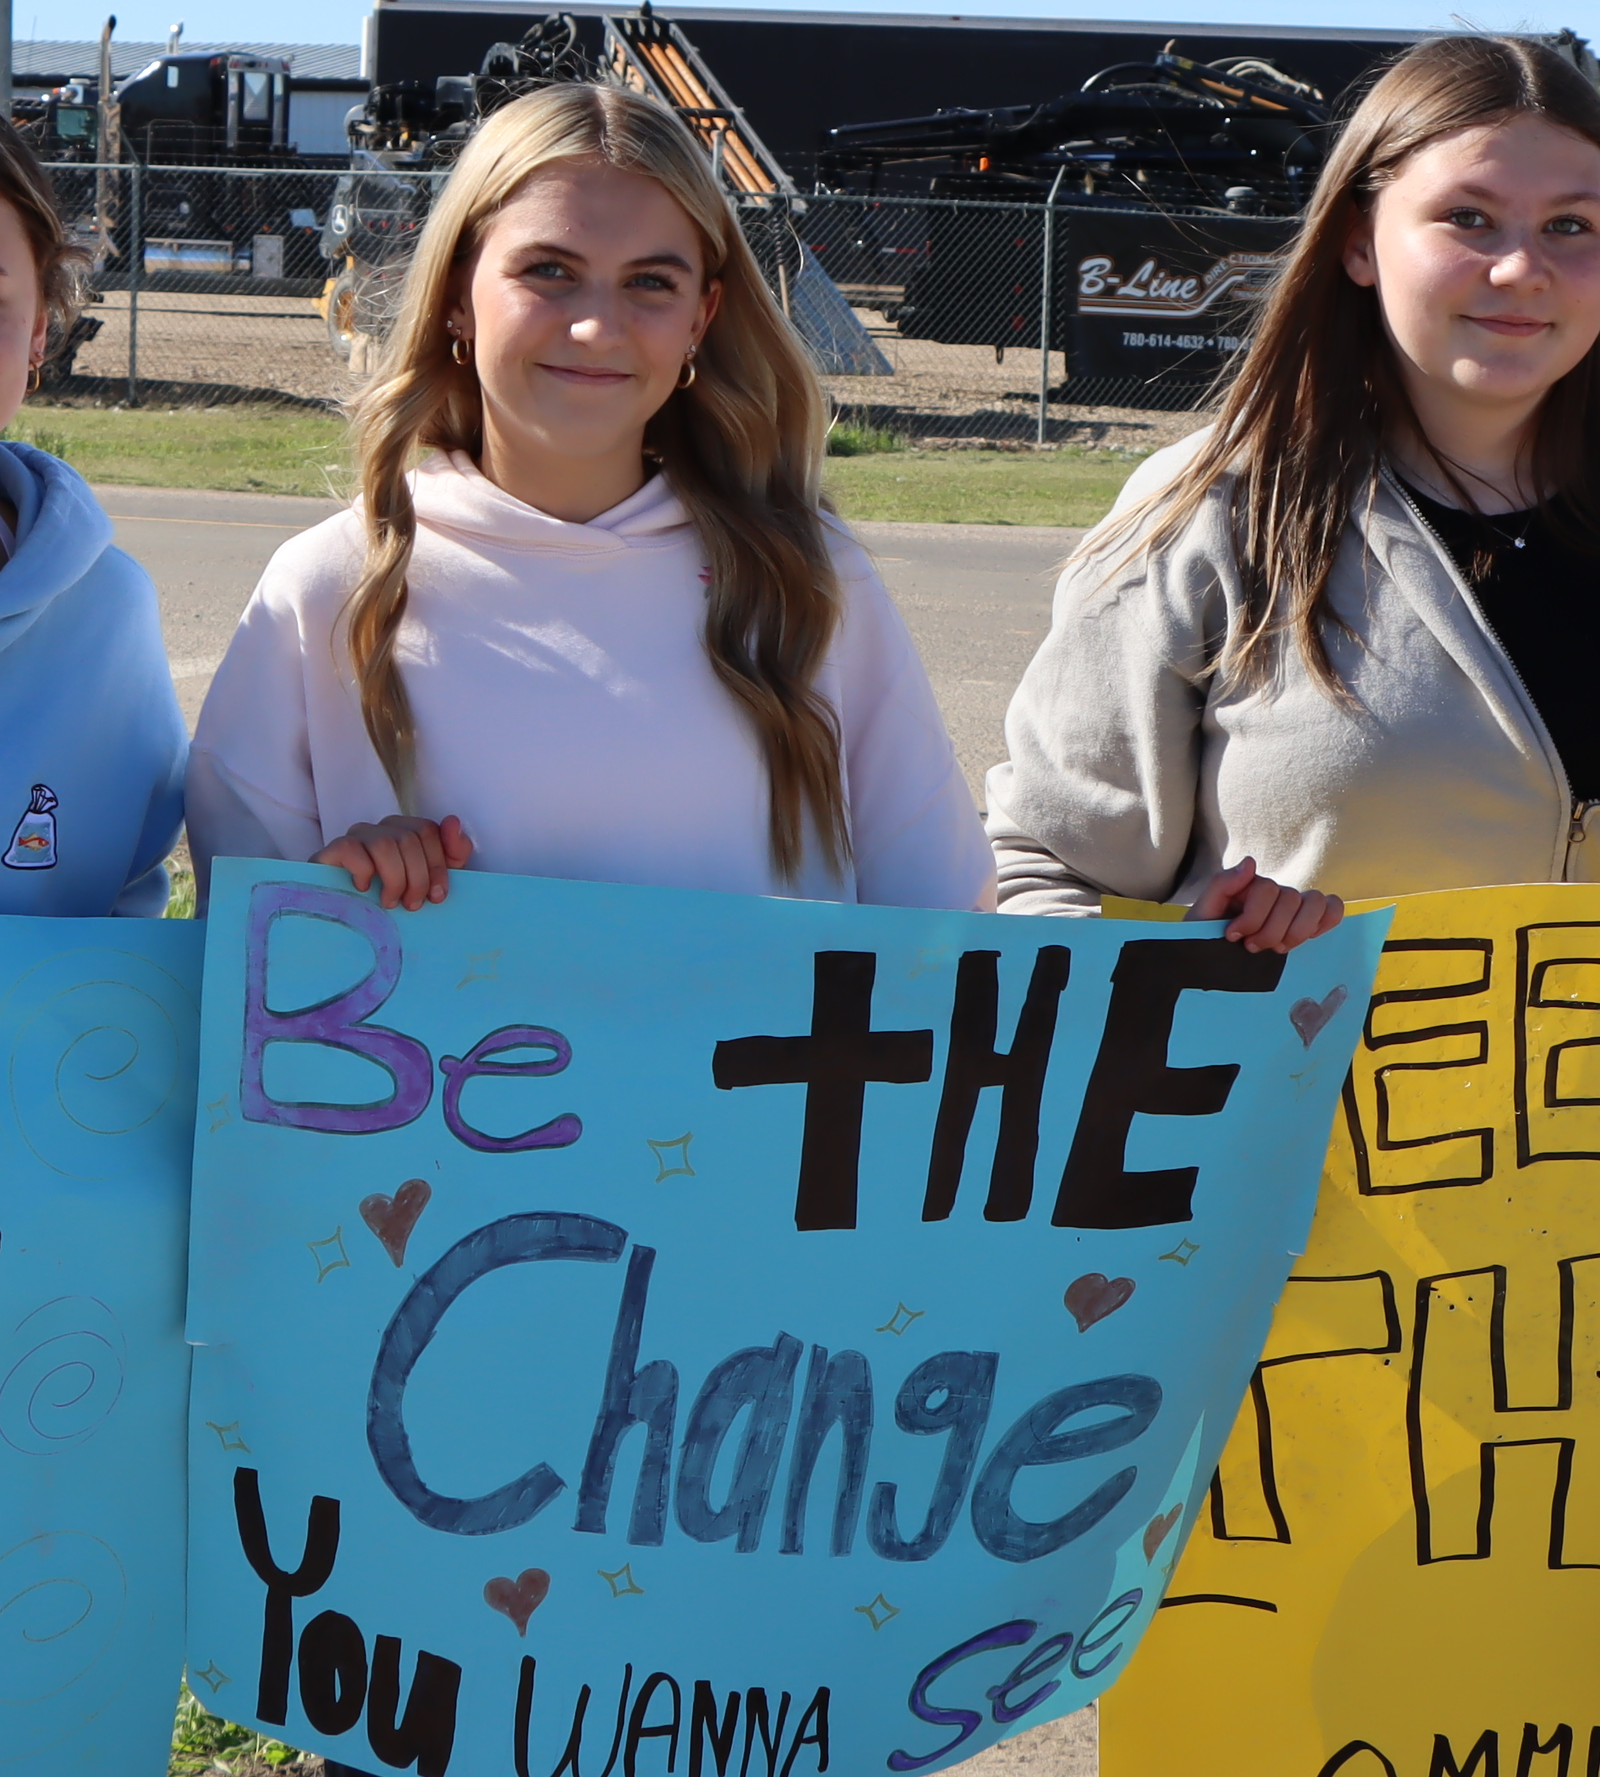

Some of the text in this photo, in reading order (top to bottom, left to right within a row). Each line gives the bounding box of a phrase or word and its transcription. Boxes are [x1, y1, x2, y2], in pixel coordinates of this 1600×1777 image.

[1079, 256, 1198, 300] B-Line
[1122, 332, 1204, 350] 780-614-4632
[239, 881, 583, 1153] Be
[366, 1211, 1162, 1563] Change
[233, 1466, 462, 1777] You
[514, 1655, 831, 1777] WANNA
